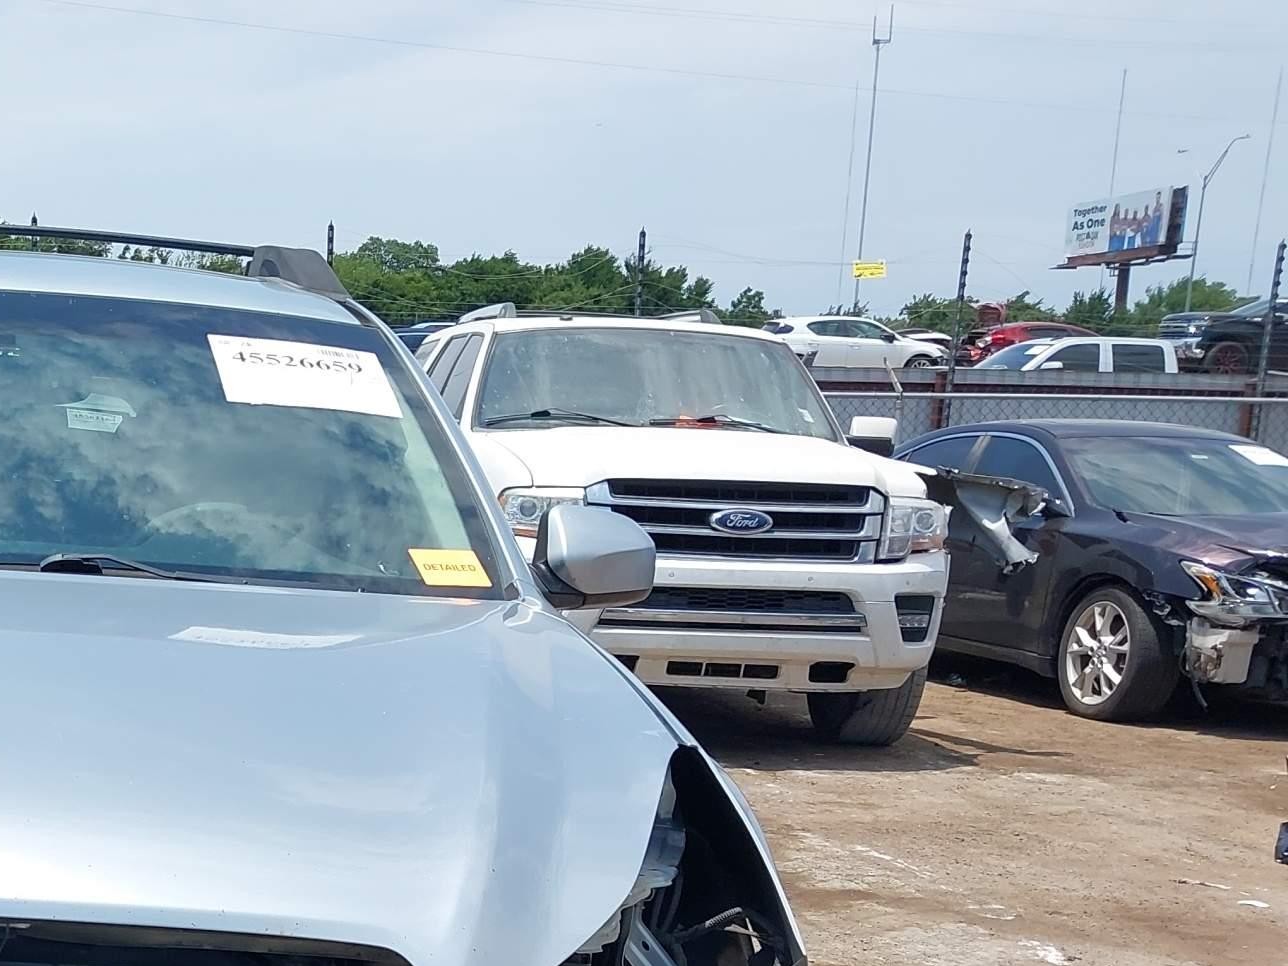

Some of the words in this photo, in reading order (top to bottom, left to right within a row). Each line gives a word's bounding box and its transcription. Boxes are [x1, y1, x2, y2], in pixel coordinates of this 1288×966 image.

[1073, 206, 1107, 217] Together
[1072, 221, 1085, 231] As
[1086, 218, 1106, 229] One
[232, 351, 362, 374] 45526659
[726, 513, 759, 527] Ford
[423, 563, 476, 572] DETAILED
